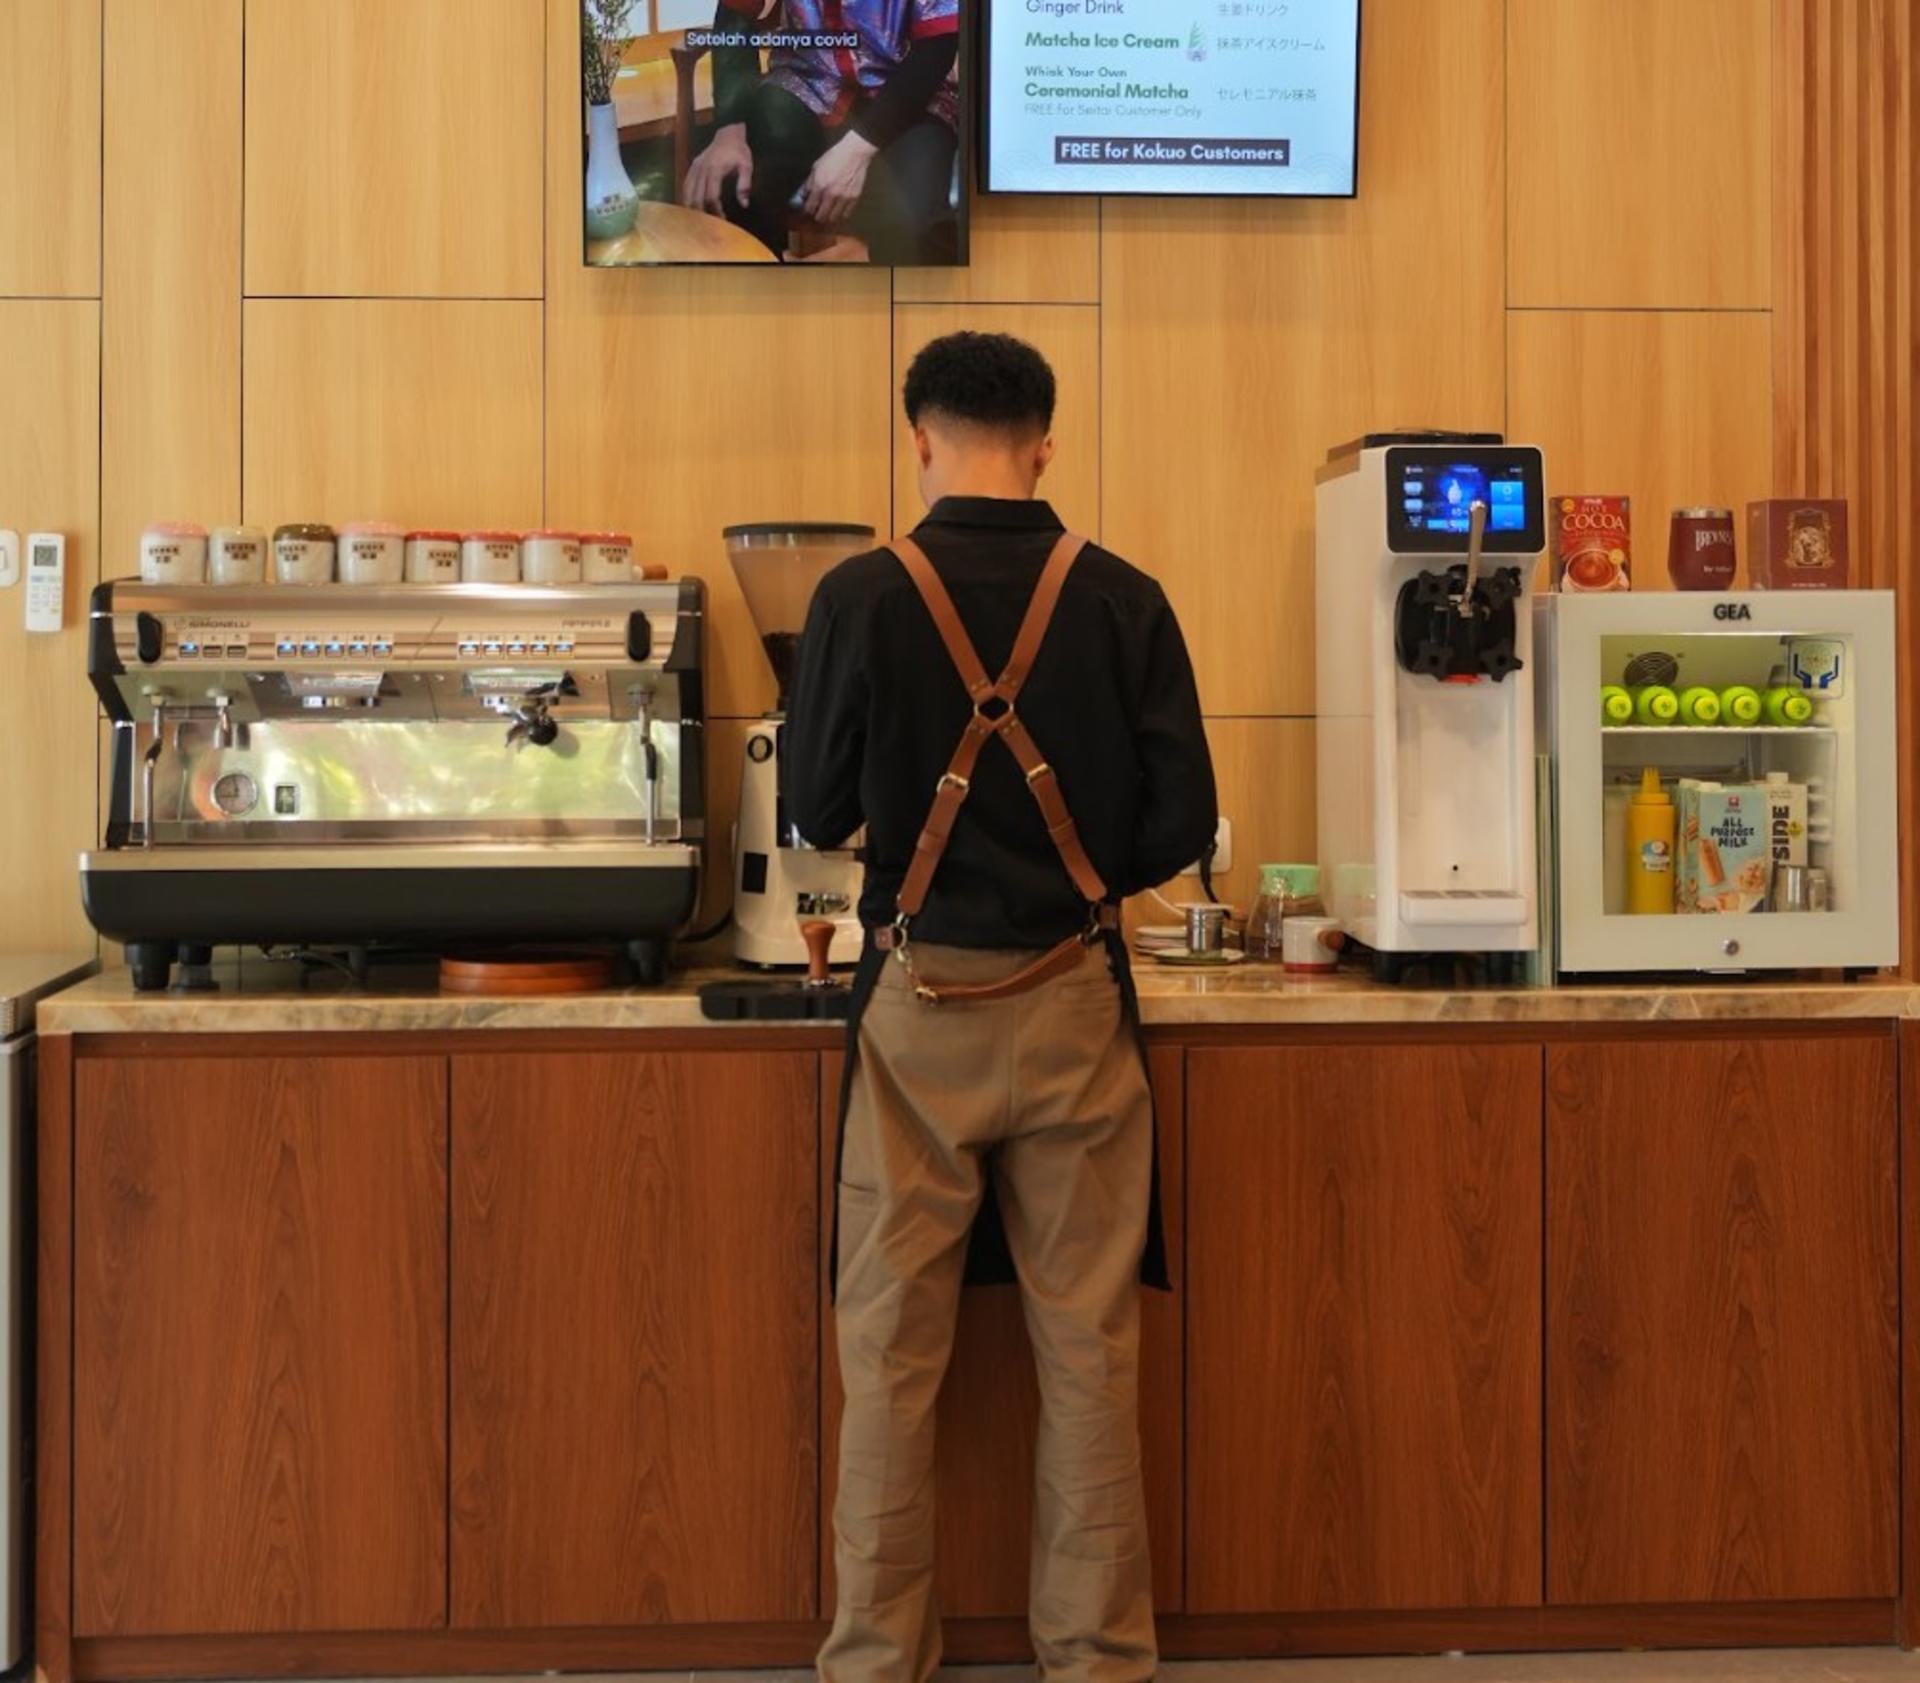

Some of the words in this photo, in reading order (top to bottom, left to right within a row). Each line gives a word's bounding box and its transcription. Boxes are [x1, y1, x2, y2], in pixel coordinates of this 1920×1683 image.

[1026, 0, 1080, 17] Ginger
[1085, 0, 1124, 14] Drink
[687, 32, 746, 47] Setelah
[750, 33, 811, 50] adanya
[814, 33, 858, 47] covid
[1025, 31, 1091, 47] Matcha
[1095, 33, 1119, 48] Ice
[1123, 33, 1180, 49] Cream
[1025, 66, 1064, 77] Whisk
[1067, 66, 1095, 78] Your
[1098, 67, 1128, 78] Own
[1025, 82, 1121, 98] Ceremonial
[1124, 83, 1189, 99] Matcha
[1025, 103, 1055, 116] FREE
[1057, 103, 1075, 116] for
[1115, 104, 1172, 117] Customer
[1175, 104, 1203, 119] Only
[1060, 142, 1100, 158] FREE
[1104, 142, 1129, 159] for
[1133, 143, 1187, 160] Kokuo
[1190, 143, 1284, 161] Customers
[1562, 512, 1626, 532] COCOA
[1713, 604, 1751, 621] GEA
[1722, 817, 1743, 828] ALL
[1710, 826, 1755, 837] PURPOSE
[1718, 837, 1748, 848] MILK
